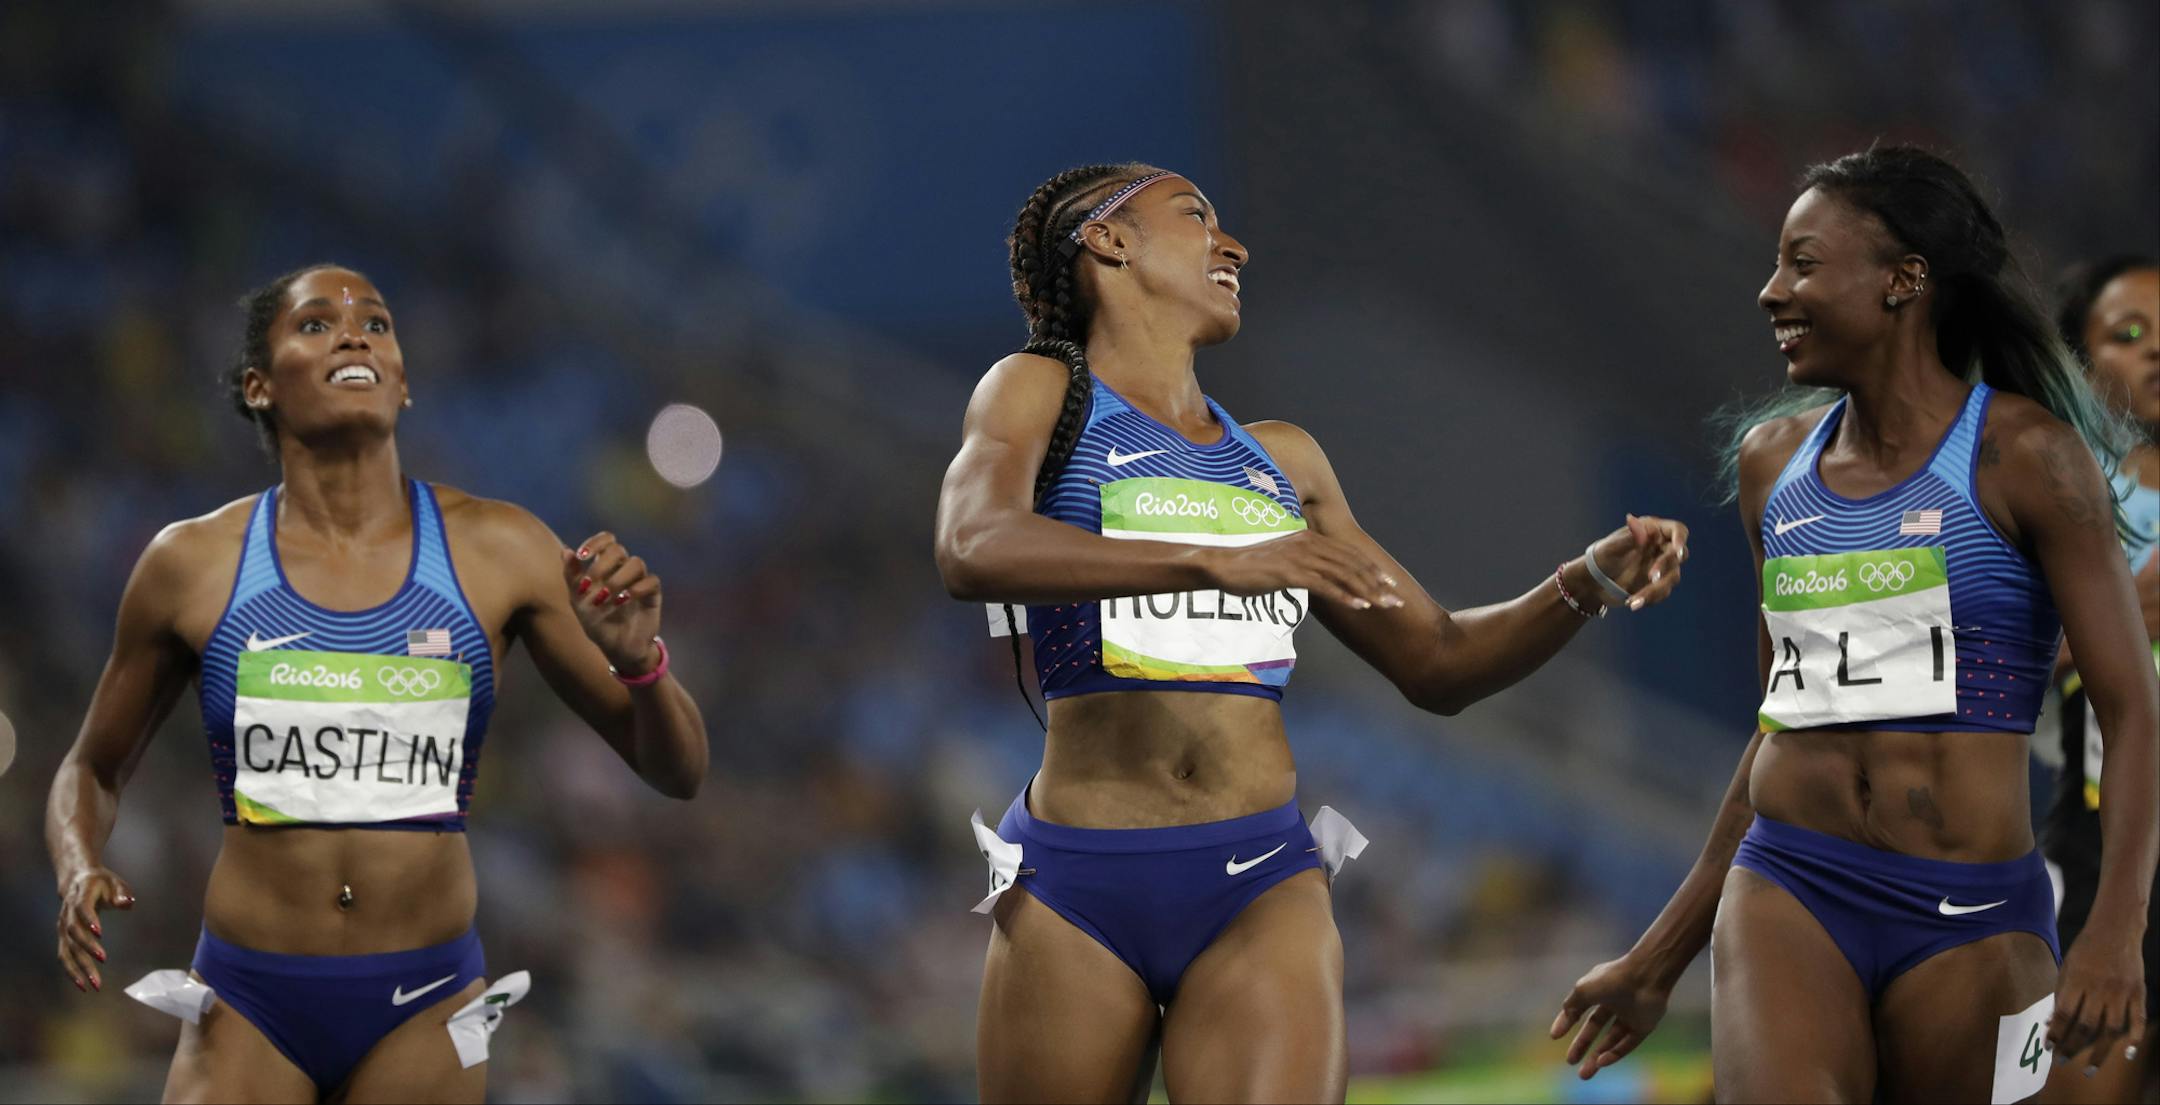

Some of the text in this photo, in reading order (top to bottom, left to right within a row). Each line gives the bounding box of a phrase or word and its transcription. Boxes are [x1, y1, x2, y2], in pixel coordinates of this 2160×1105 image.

[1135, 492, 1219, 520] Rio2016
[1775, 568, 1848, 596] Rio2016
[270, 662, 363, 690] Rio2016
[243, 723, 455, 787] CASTLIN
[2019, 1022, 2043, 1075] 4
